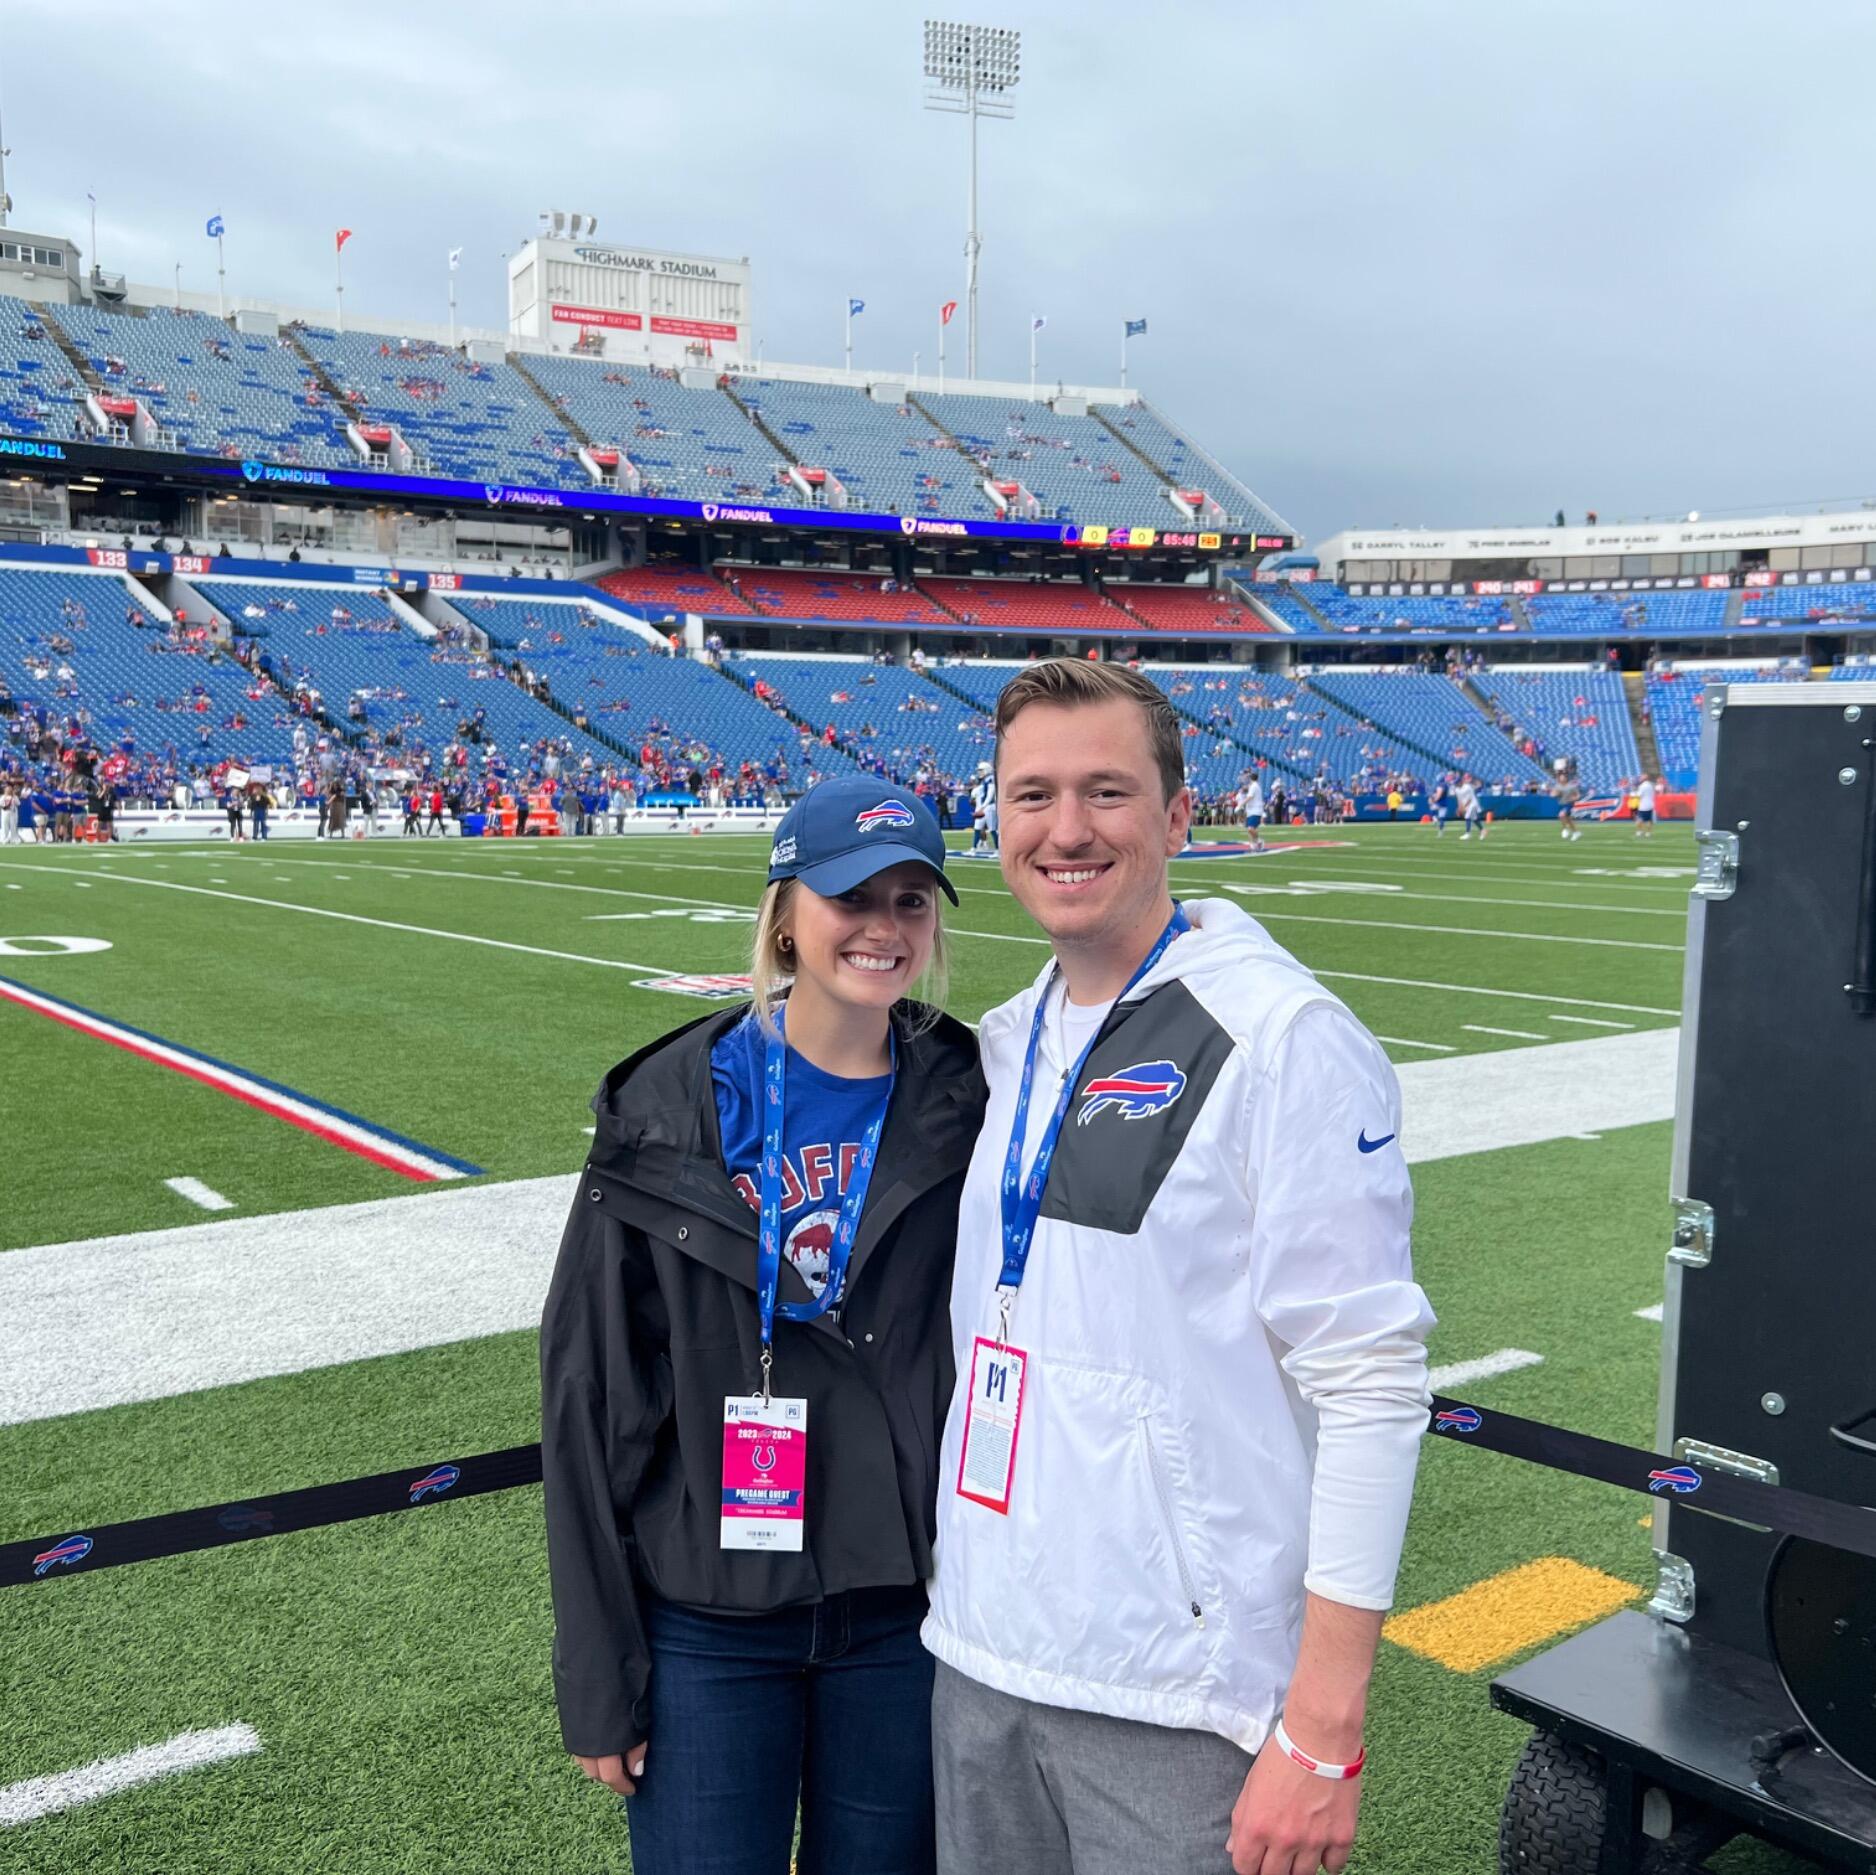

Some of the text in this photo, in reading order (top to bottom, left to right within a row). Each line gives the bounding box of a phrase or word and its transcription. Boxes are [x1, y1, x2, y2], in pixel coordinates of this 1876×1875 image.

[582, 251, 717, 279] HIGHMARK STADIUM
[571, 311, 605, 323] CONDUCT
[0, 439, 66, 460] ANDUEL
[265, 466, 331, 486] FANDUEL
[505, 490, 564, 507] FANDUEL
[720, 508, 774, 524] FANDUEL
[917, 521, 969, 536] FANDUEL
[96, 551, 127, 567] 133
[174, 557, 203, 572] 134
[429, 573, 456, 588] 135
[728, 1404, 739, 1416] P1
[737, 1428, 792, 1440] 2023 2024
